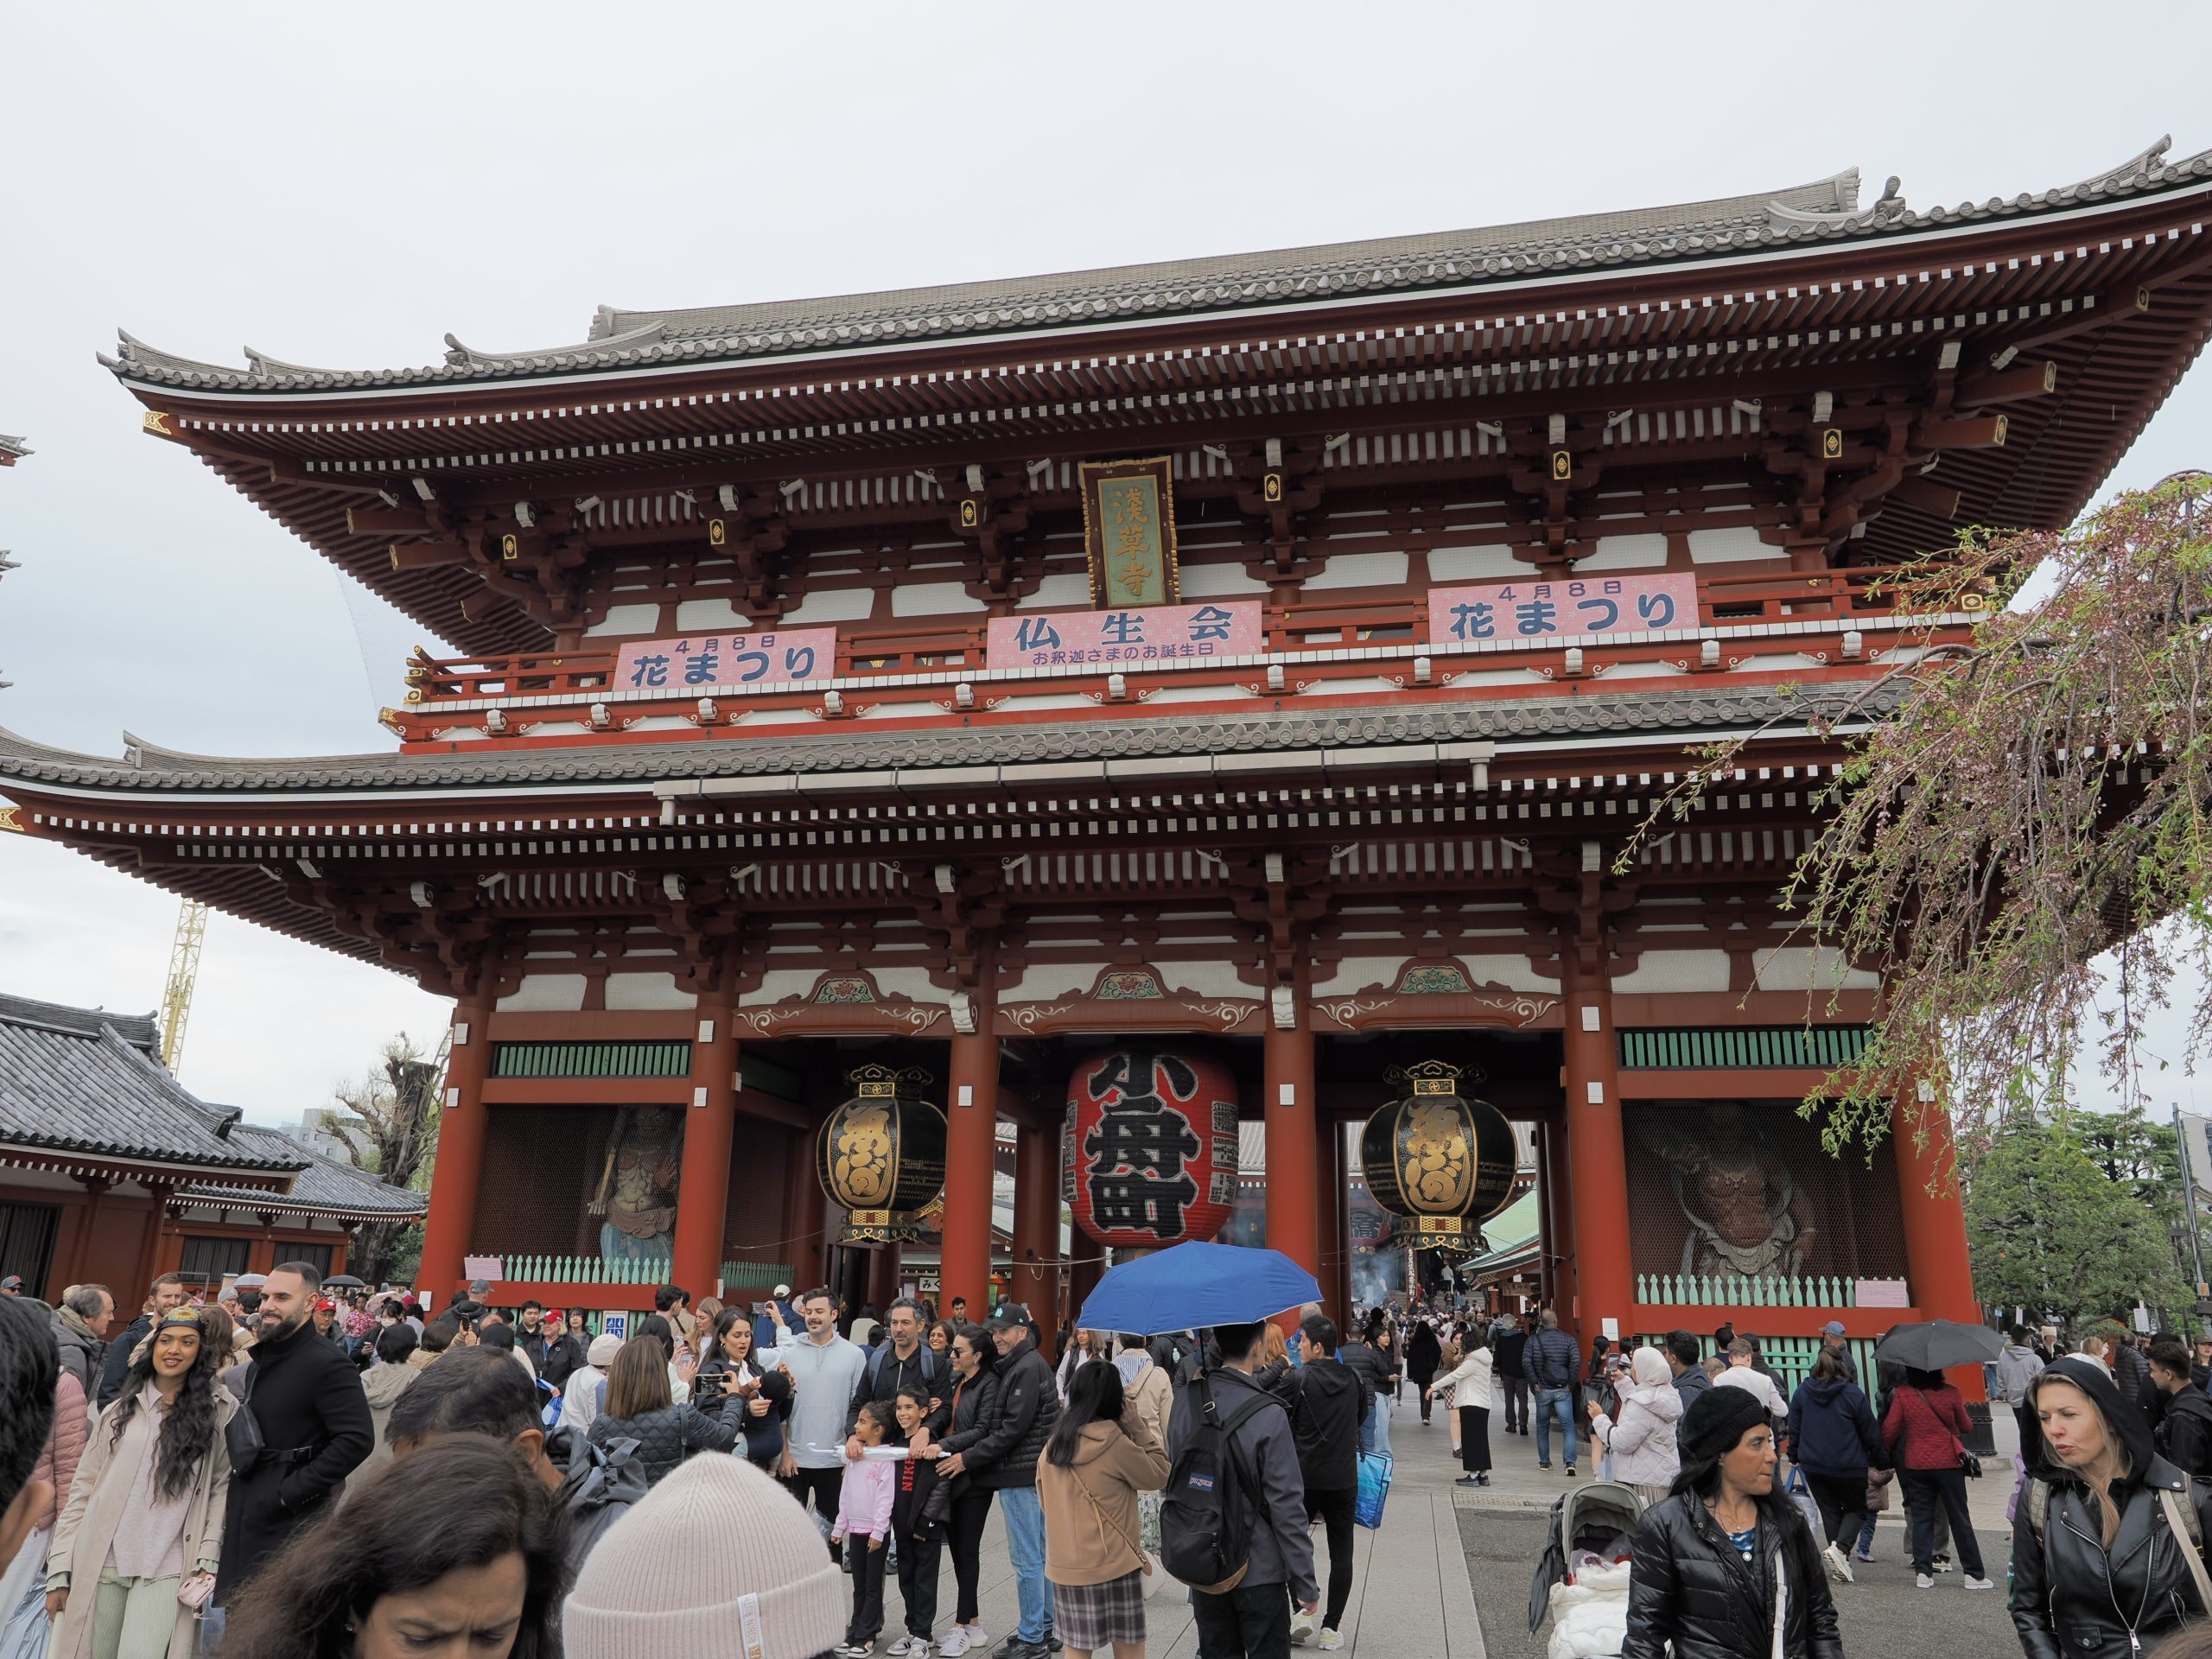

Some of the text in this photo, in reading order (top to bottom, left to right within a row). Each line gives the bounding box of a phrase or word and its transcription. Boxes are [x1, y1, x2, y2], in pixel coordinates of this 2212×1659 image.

[1014, 606, 1234, 652] 仏生会
[1449, 593, 1675, 641] 花まつり
[631, 646, 815, 688] 花まつり
[1033, 642, 1215, 665] お釈迦さまのお誕生日
[901, 1458, 916, 1491] NIKE
[746, 1618, 759, 1644] ROBIN
